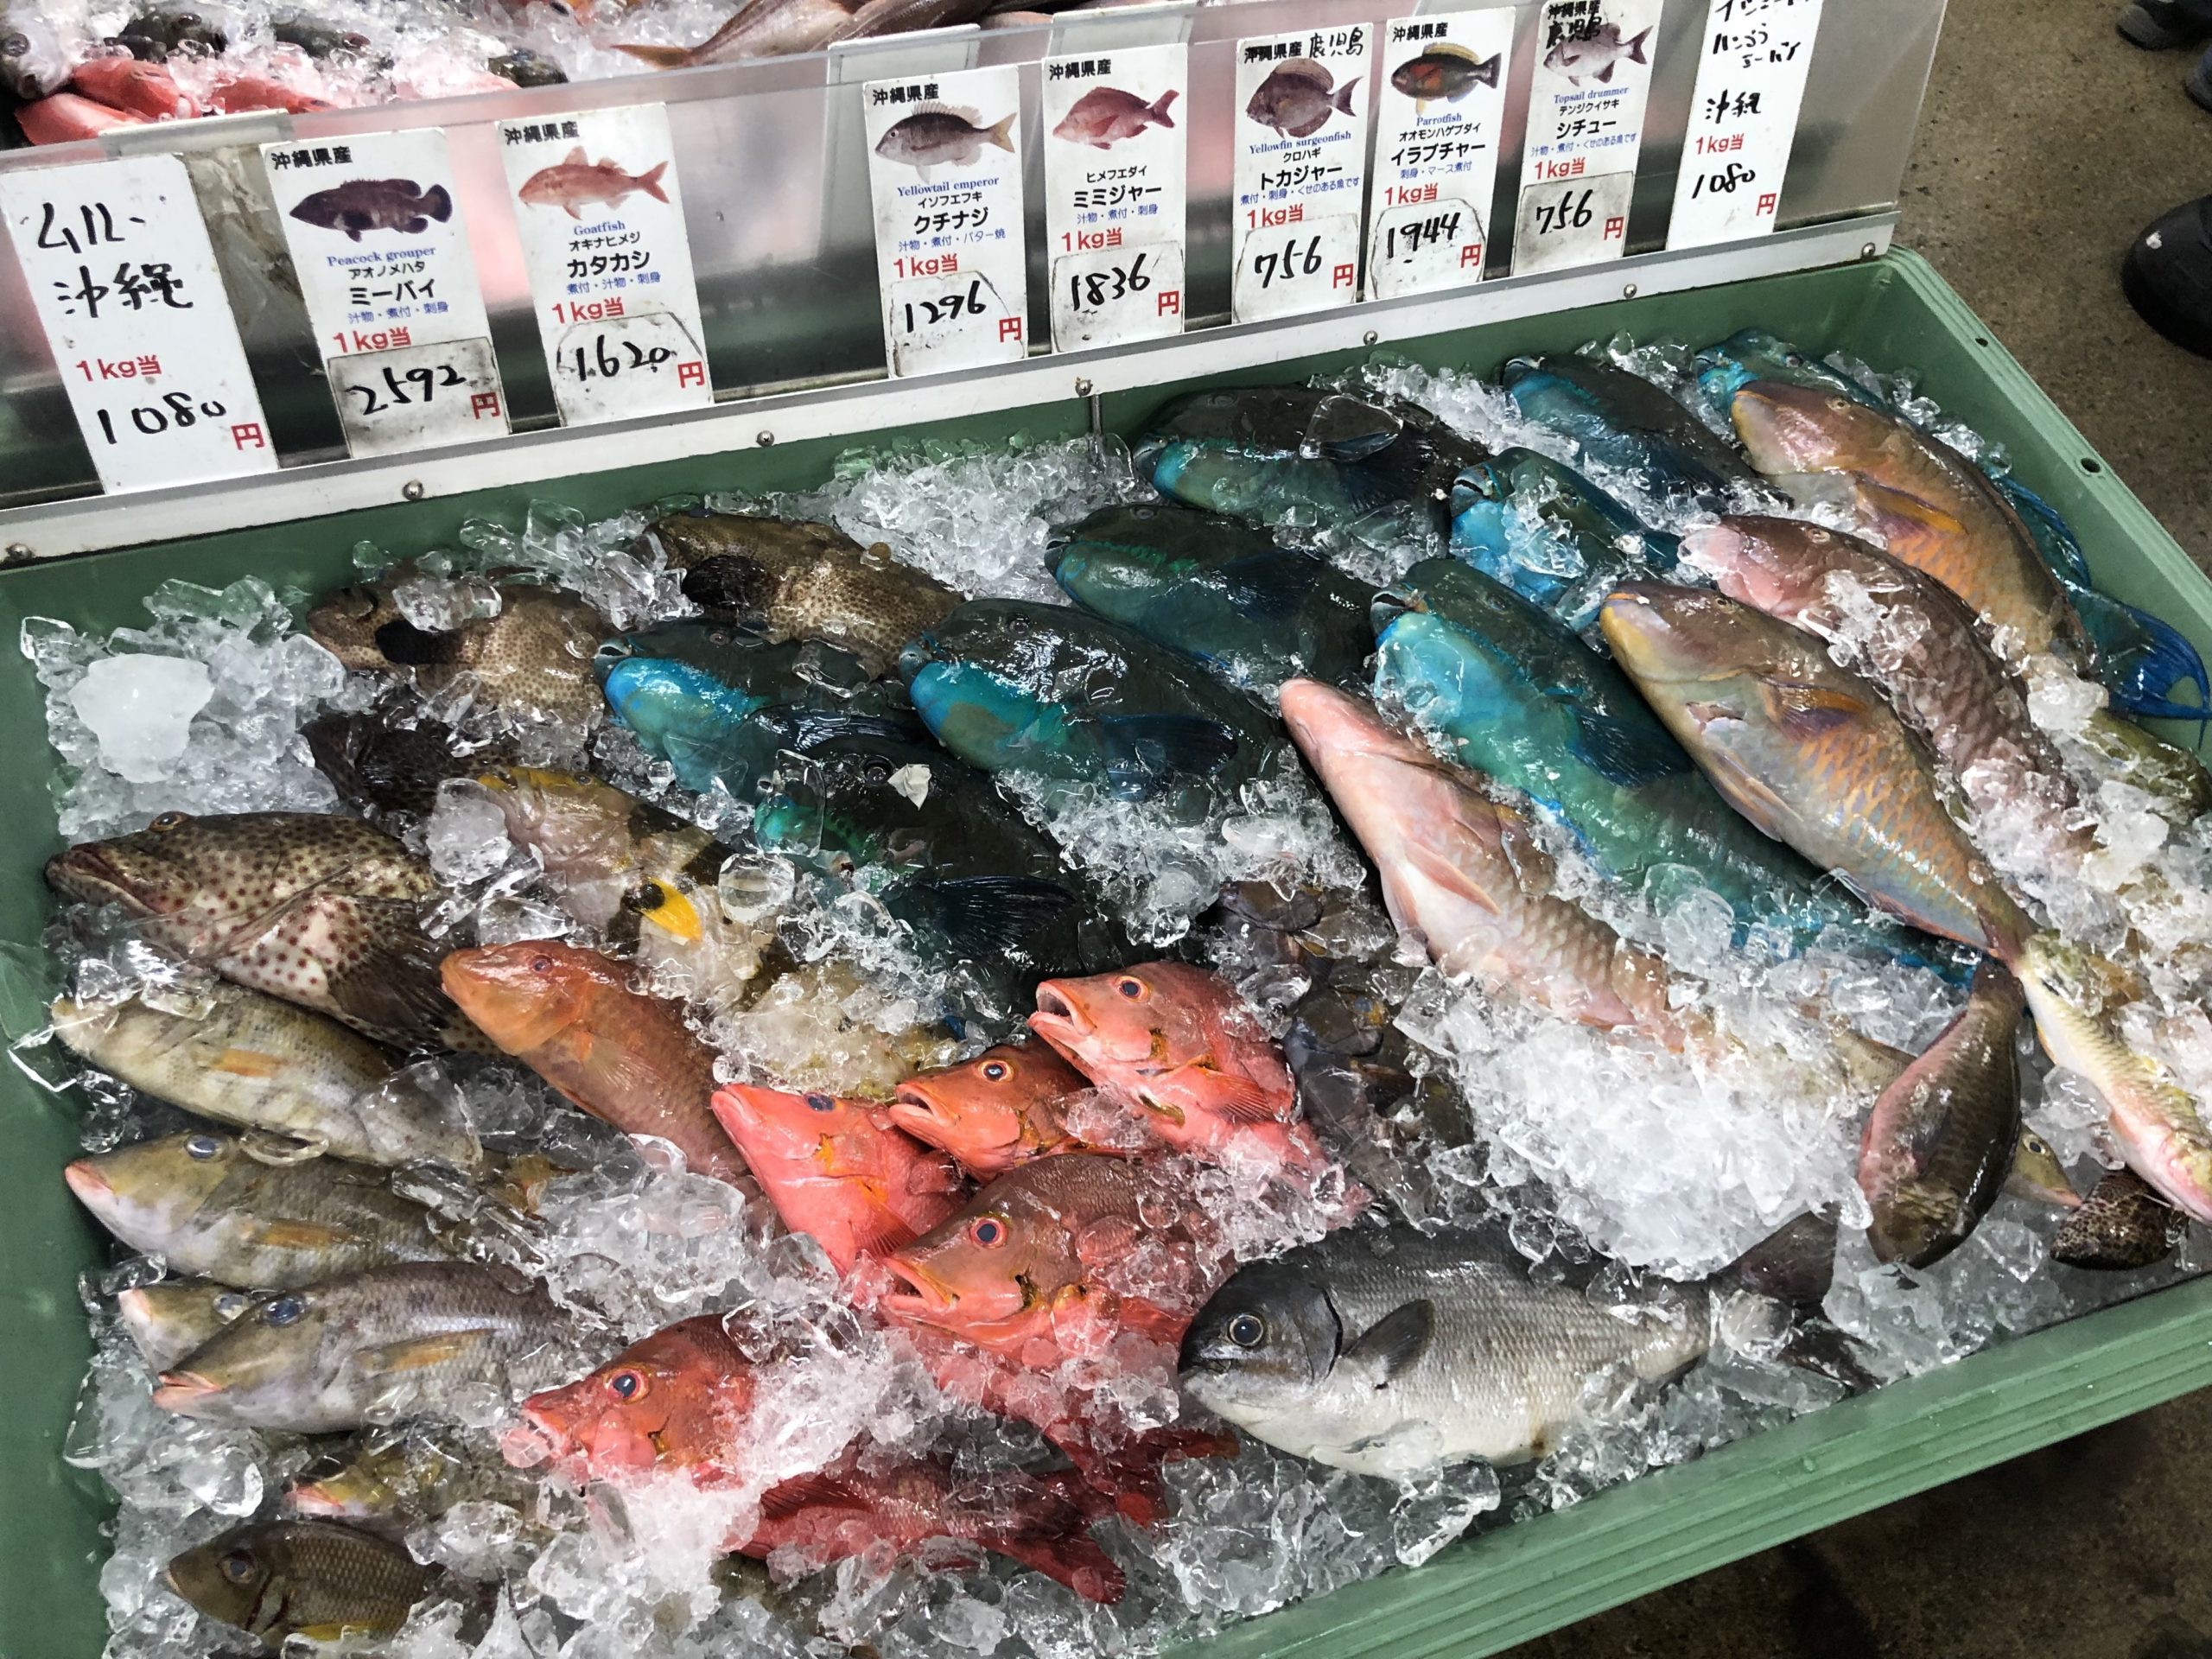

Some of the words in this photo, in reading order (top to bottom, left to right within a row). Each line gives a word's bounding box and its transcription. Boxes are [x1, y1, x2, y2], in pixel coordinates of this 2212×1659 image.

[1393, 22, 1448, 42] 沖縄県産
[1049, 58, 1112, 81] 沖縄県産
[873, 84, 940, 105] 沖縄県産
[1554, 91, 1585, 105] Topsail
[1587, 86, 1630, 101] drummer
[1559, 99, 1620, 116] テンジクイサキ
[1416, 113, 1462, 127] Parrotfish
[1556, 118, 1617, 140] シチュー
[505, 121, 581, 145] 沖縄県産
[1249, 139, 1293, 154] Yellowfin
[1296, 130, 1351, 149] surgeonfish
[1695, 133, 1745, 155] 1kg当
[271, 146, 353, 170] 沖縄県産
[1283, 147, 1321, 163] クロハギ
[1391, 142, 1485, 167] イラブチャー
[1087, 165, 1147, 183] ヒメフエダイ
[1261, 164, 1343, 191] トカジャー
[1535, 156, 1586, 180] 1kg当
[897, 181, 950, 197] Yellowtail
[953, 177, 1001, 193] emperor
[1074, 185, 1162, 209] ミミジャー
[1384, 182, 1439, 207] 1kg当
[1692, 162, 1756, 199] 1080
[1755, 193, 1777, 216] 円
[918, 192, 982, 209] イソフエフキ
[913, 207, 989, 235] クチナジ
[1247, 203, 1304, 228] 1kg当
[1536, 189, 1594, 235] 756
[1604, 216, 1624, 240] 円
[574, 221, 626, 236] Goatfish
[1061, 227, 1122, 252] 1kg当
[1388, 212, 1461, 259] 1944
[1460, 244, 1481, 269] 円
[569, 232, 641, 252] オキナヒメジ
[327, 251, 383, 267] Peacock
[385, 246, 436, 262] grouper
[567, 251, 650, 279] カタカシ
[893, 253, 958, 278] 1kg当
[1254, 235, 1322, 289] 756
[1332, 264, 1354, 289] 円
[348, 261, 426, 280] アオノメハタ
[350, 279, 435, 306] ミーバイ
[1071, 253, 1150, 311] 1836
[1157, 290, 1180, 316] 円
[552, 296, 626, 324] 1kg当
[906, 280, 987, 333] 1296
[1000, 316, 1022, 342] 円
[334, 327, 413, 353] 1kg当
[76, 354, 162, 382] 1kg当
[576, 334, 671, 381] 1620
[677, 361, 706, 388] 円
[346, 365, 467, 416] 2592
[471, 391, 501, 420] 円
[98, 391, 227, 444] 1080
[231, 423, 265, 450] 円
